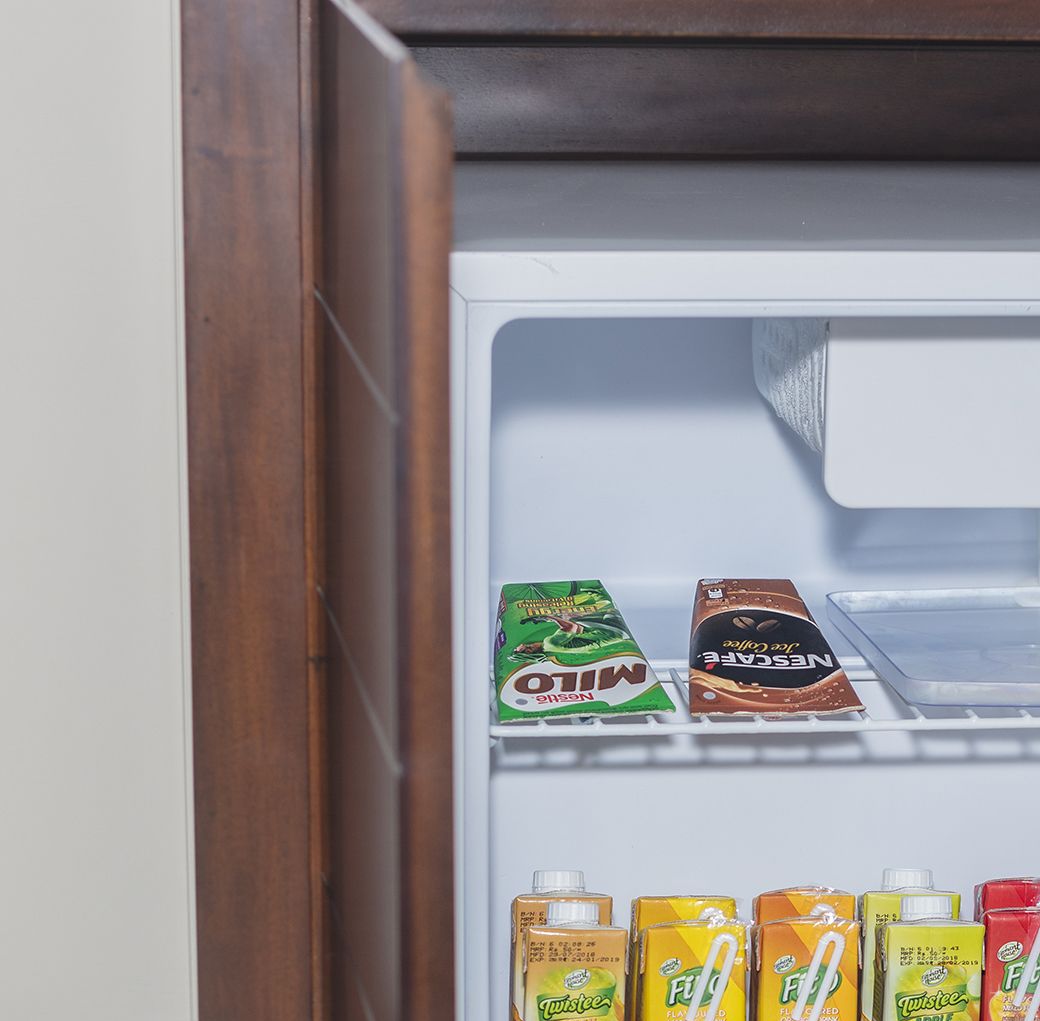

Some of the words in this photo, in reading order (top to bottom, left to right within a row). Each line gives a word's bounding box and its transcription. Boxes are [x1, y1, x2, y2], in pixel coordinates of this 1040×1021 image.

[722, 640, 769, 654] Coffee
[513, 662, 647, 695] MILO
[538, 993, 612, 1020] Twistee
[780, 1007, 839, 1015] FLORED
[897, 989, 969, 1017] Twistee
[667, 1009, 726, 1018] FLAUD
